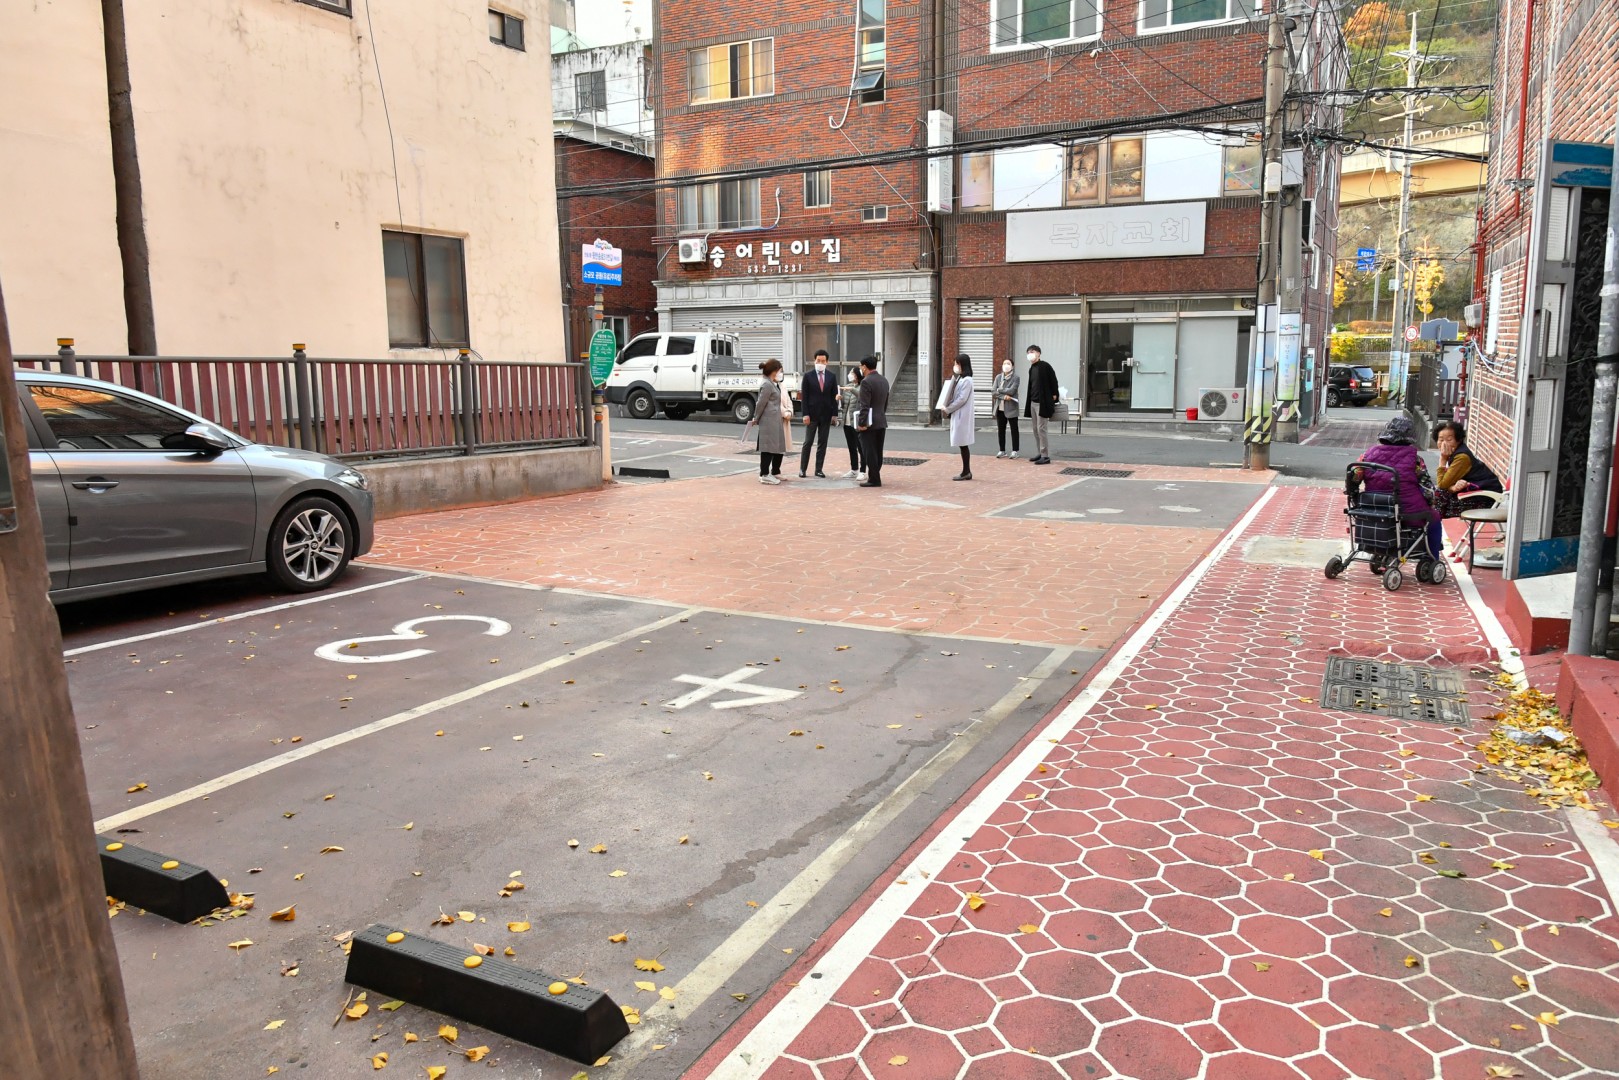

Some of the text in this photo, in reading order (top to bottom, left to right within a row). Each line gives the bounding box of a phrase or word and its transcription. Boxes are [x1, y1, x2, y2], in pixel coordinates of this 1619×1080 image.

[1049, 217, 1191, 249] 목자교회
[709, 238, 841, 268] 송어린이집
[313, 614, 512, 664] 3
[661, 667, 805, 710] 4
